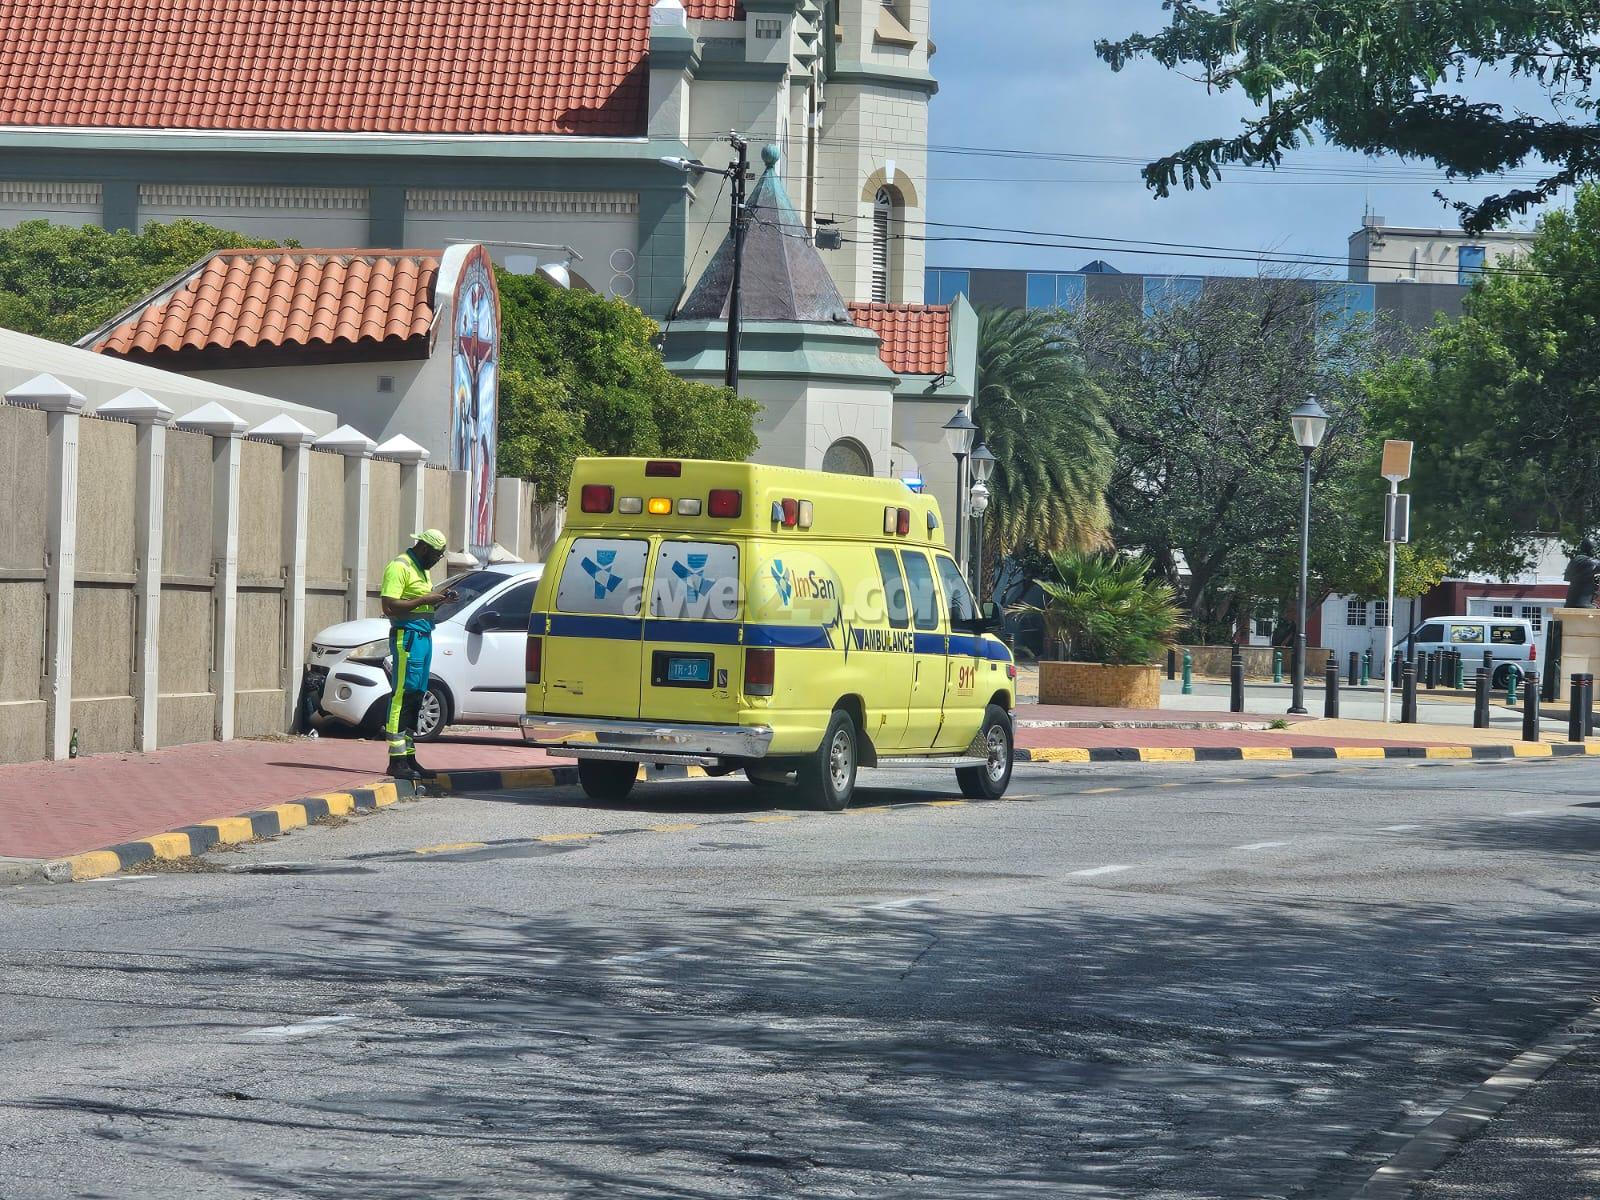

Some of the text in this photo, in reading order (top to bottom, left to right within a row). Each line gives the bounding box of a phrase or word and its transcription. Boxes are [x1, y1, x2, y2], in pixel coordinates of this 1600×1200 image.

[791, 568, 836, 600] ImSan
[863, 628, 913, 653] AMBULANCE
[958, 665, 975, 689] 911
